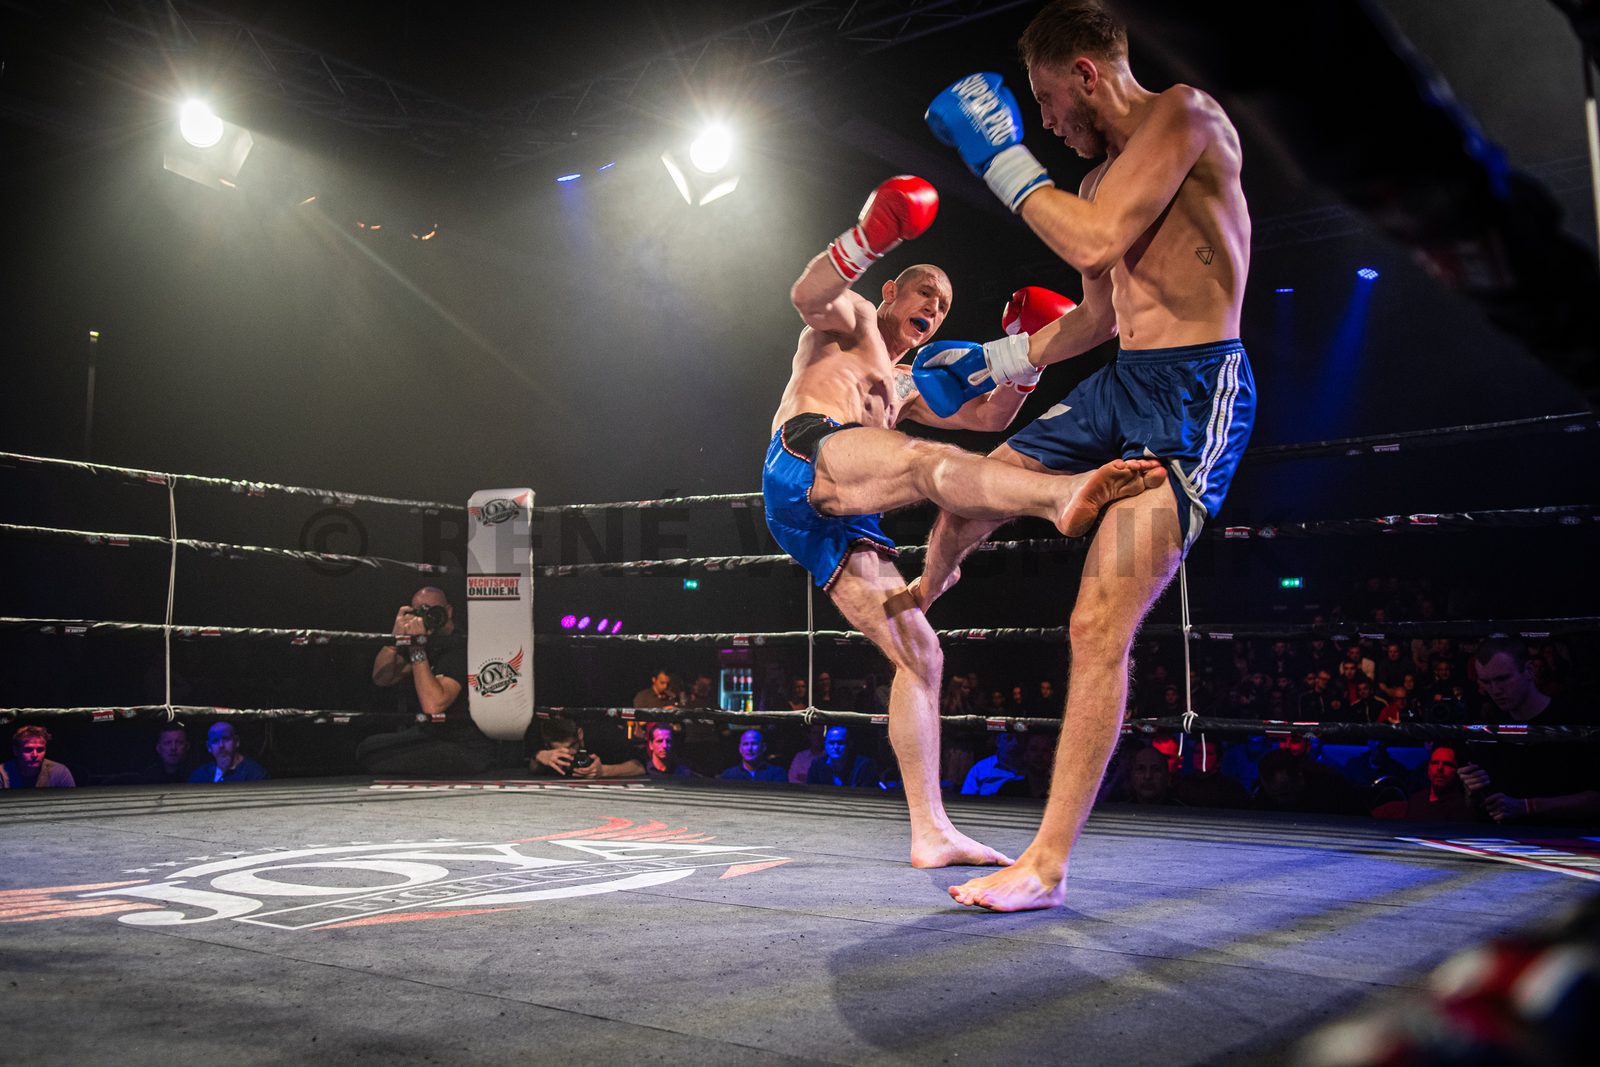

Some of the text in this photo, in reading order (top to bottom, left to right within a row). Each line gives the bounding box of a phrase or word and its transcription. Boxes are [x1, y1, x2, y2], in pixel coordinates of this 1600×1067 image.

[951, 72, 999, 120] SUPER
[981, 105, 1018, 147] PRO
[475, 499, 520, 522] JOYA
[468, 578, 520, 587] VECHTSPORT
[468, 587, 520, 596] ONLINE.NL
[475, 662, 518, 691] JOYA
[77, 839, 777, 926] JOYA
[327, 860, 700, 912] FIGHTGEAR
